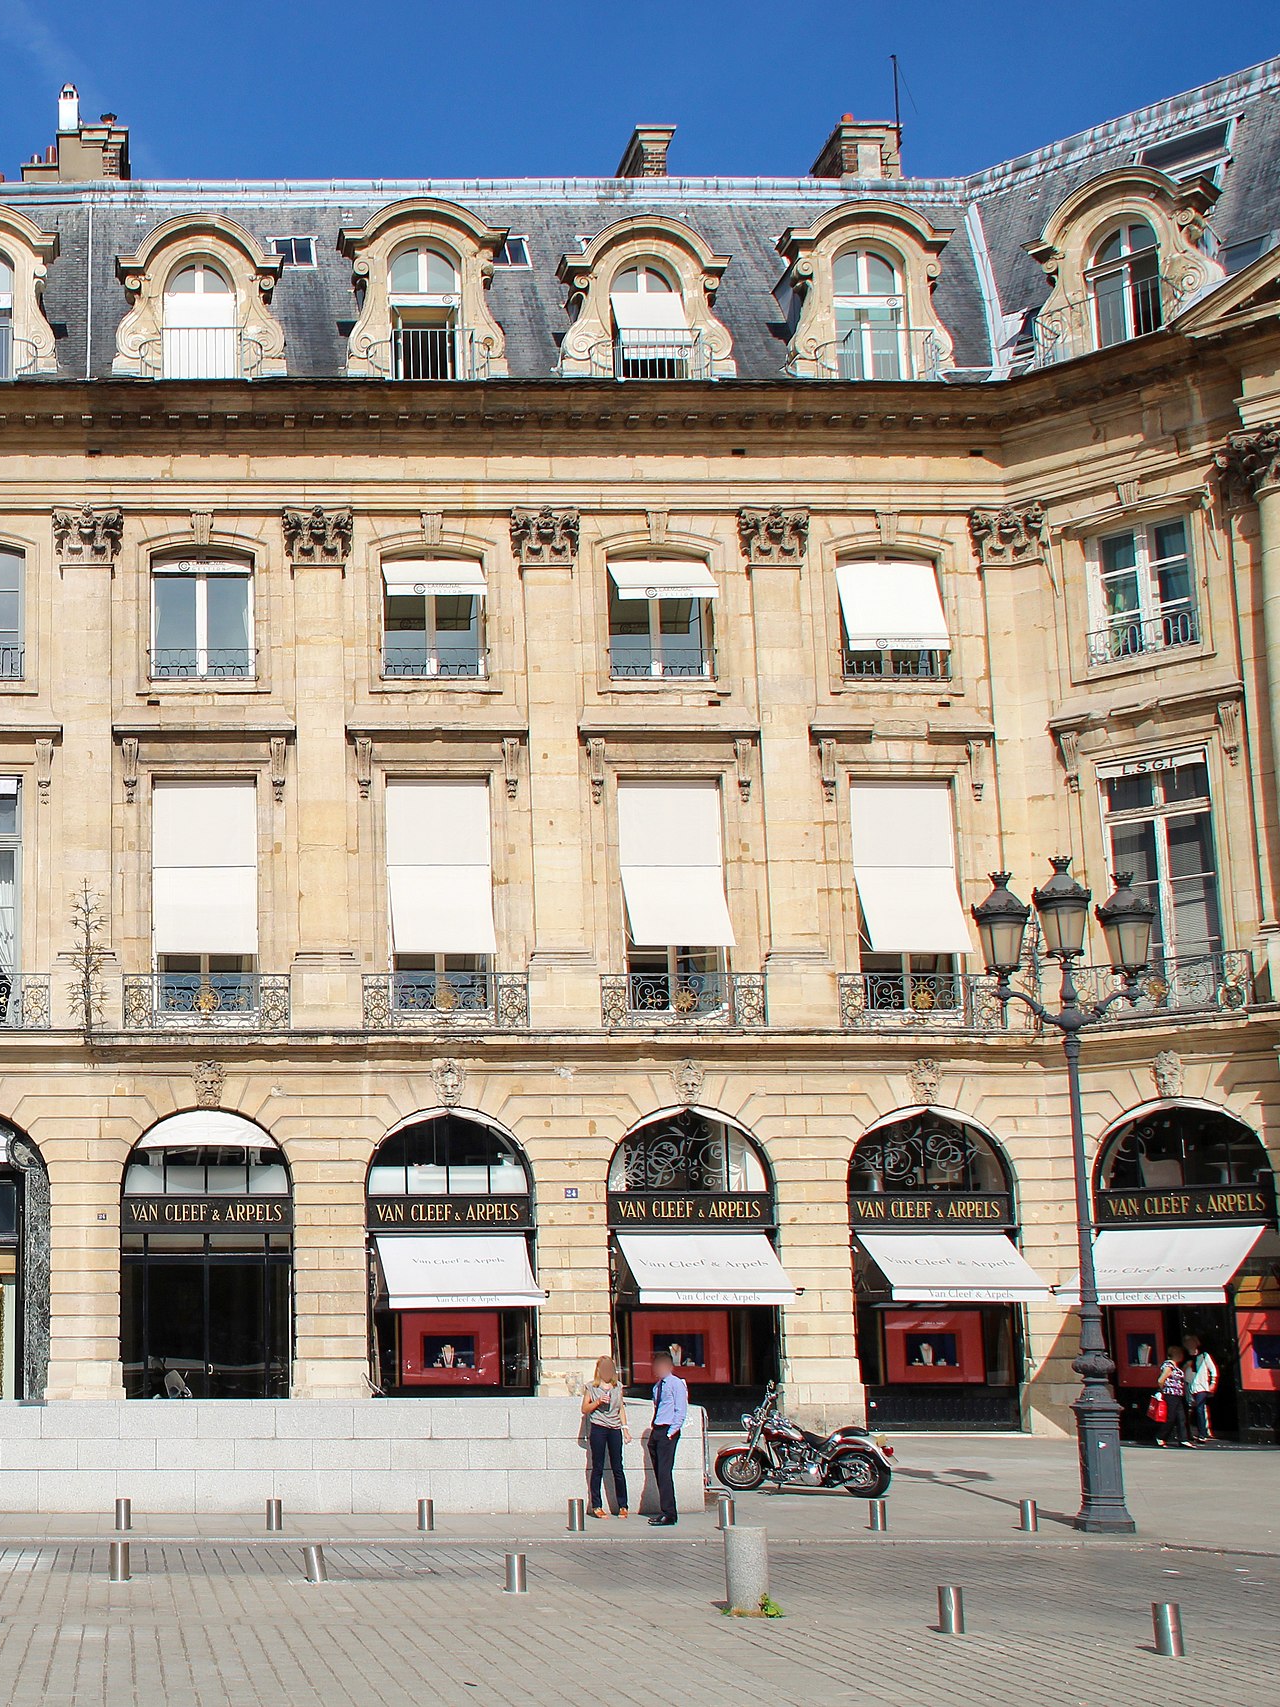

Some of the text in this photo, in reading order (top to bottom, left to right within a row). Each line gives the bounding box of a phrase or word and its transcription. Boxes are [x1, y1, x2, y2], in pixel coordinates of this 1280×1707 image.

[1122, 758, 1178, 776] L.S.G.I.
[618, 1200, 761, 1218] VAN CLEEF & ARPELS
[856, 1201, 1000, 1218] VAN CLEEF & ARPELS
[1106, 1193, 1266, 1216] VAN CLEEF & ARPELS
[131, 1204, 282, 1222] VAN CLEEF & ARPELS
[376, 1204, 519, 1222] VAN CLEEF & ARPELS
[639, 1258, 666, 1268] Van
[669, 1258, 705, 1268] Cleef
[725, 1260, 769, 1270] Arpels
[884, 1255, 912, 1265] Van
[914, 1258, 952, 1266] Cleef
[970, 1259, 1015, 1269] Arpels
[1182, 1264, 1230, 1273] Arpels
[676, 1292, 694, 1300] Van
[696, 1292, 719, 1301] Cleef
[732, 1292, 760, 1303] Arpels
[929, 1289, 946, 1298] Van
[948, 1289, 973, 1298] Cleef
[984, 1290, 1014, 1300] Arpels
[1114, 1292, 1140, 1301] Cleef
[1154, 1292, 1185, 1302] Arpels
